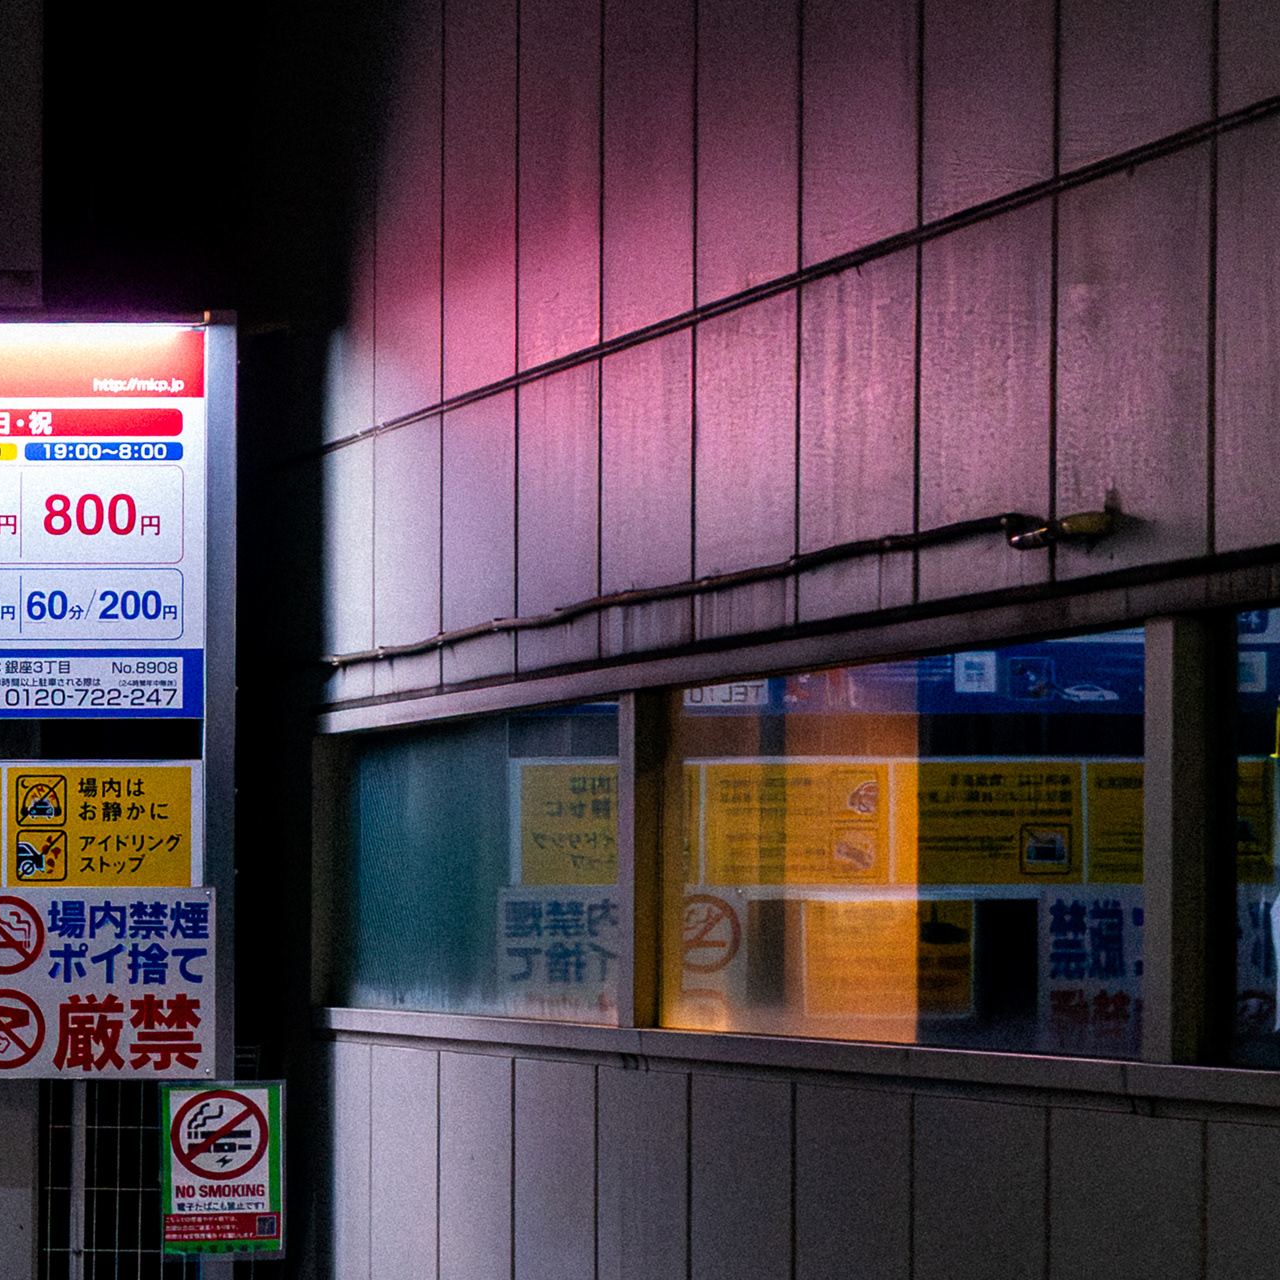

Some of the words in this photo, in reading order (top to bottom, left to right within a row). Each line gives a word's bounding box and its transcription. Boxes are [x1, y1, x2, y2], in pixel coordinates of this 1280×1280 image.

[92, 377, 185, 393] http://mkp.jp
[43, 493, 161, 536] 800円
[111, 661, 178, 674] No.8908
[77, 777, 146, 798] 場内は
[78, 801, 170, 822] お静かに
[79, 833, 182, 852] アイドリング
[79, 854, 146, 874] ストップ
[47, 900, 209, 940] 場内禁煙
[47, 942, 208, 986] ポイ捨て
[52, 993, 203, 1072] 厳禁
[175, 1184, 196, 1199] NO
[198, 1183, 266, 1198] SMOKING
